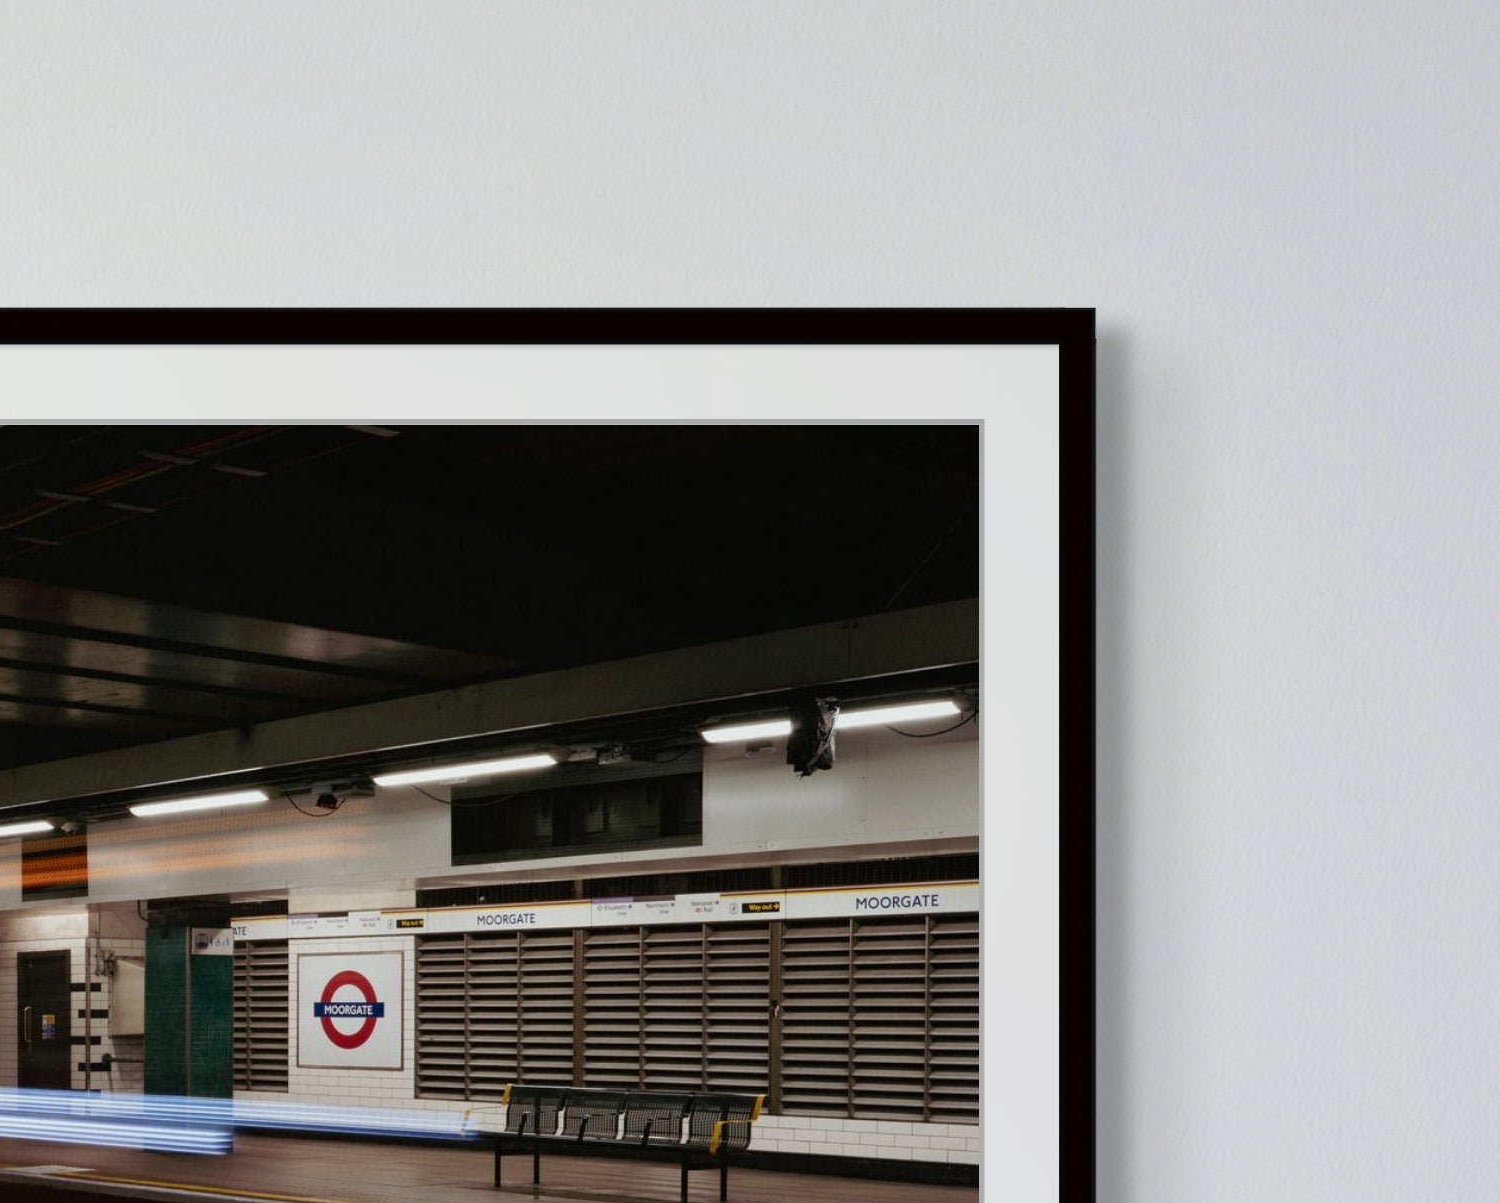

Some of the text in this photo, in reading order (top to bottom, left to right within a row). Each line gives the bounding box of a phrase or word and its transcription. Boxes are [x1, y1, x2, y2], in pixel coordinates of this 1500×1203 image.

[748, 903, 773, 912] Way out
[855, 894, 939, 910] MOORGATE
[477, 912, 536, 926] MOORGATE
[324, 1005, 373, 1015] MOORGATE
